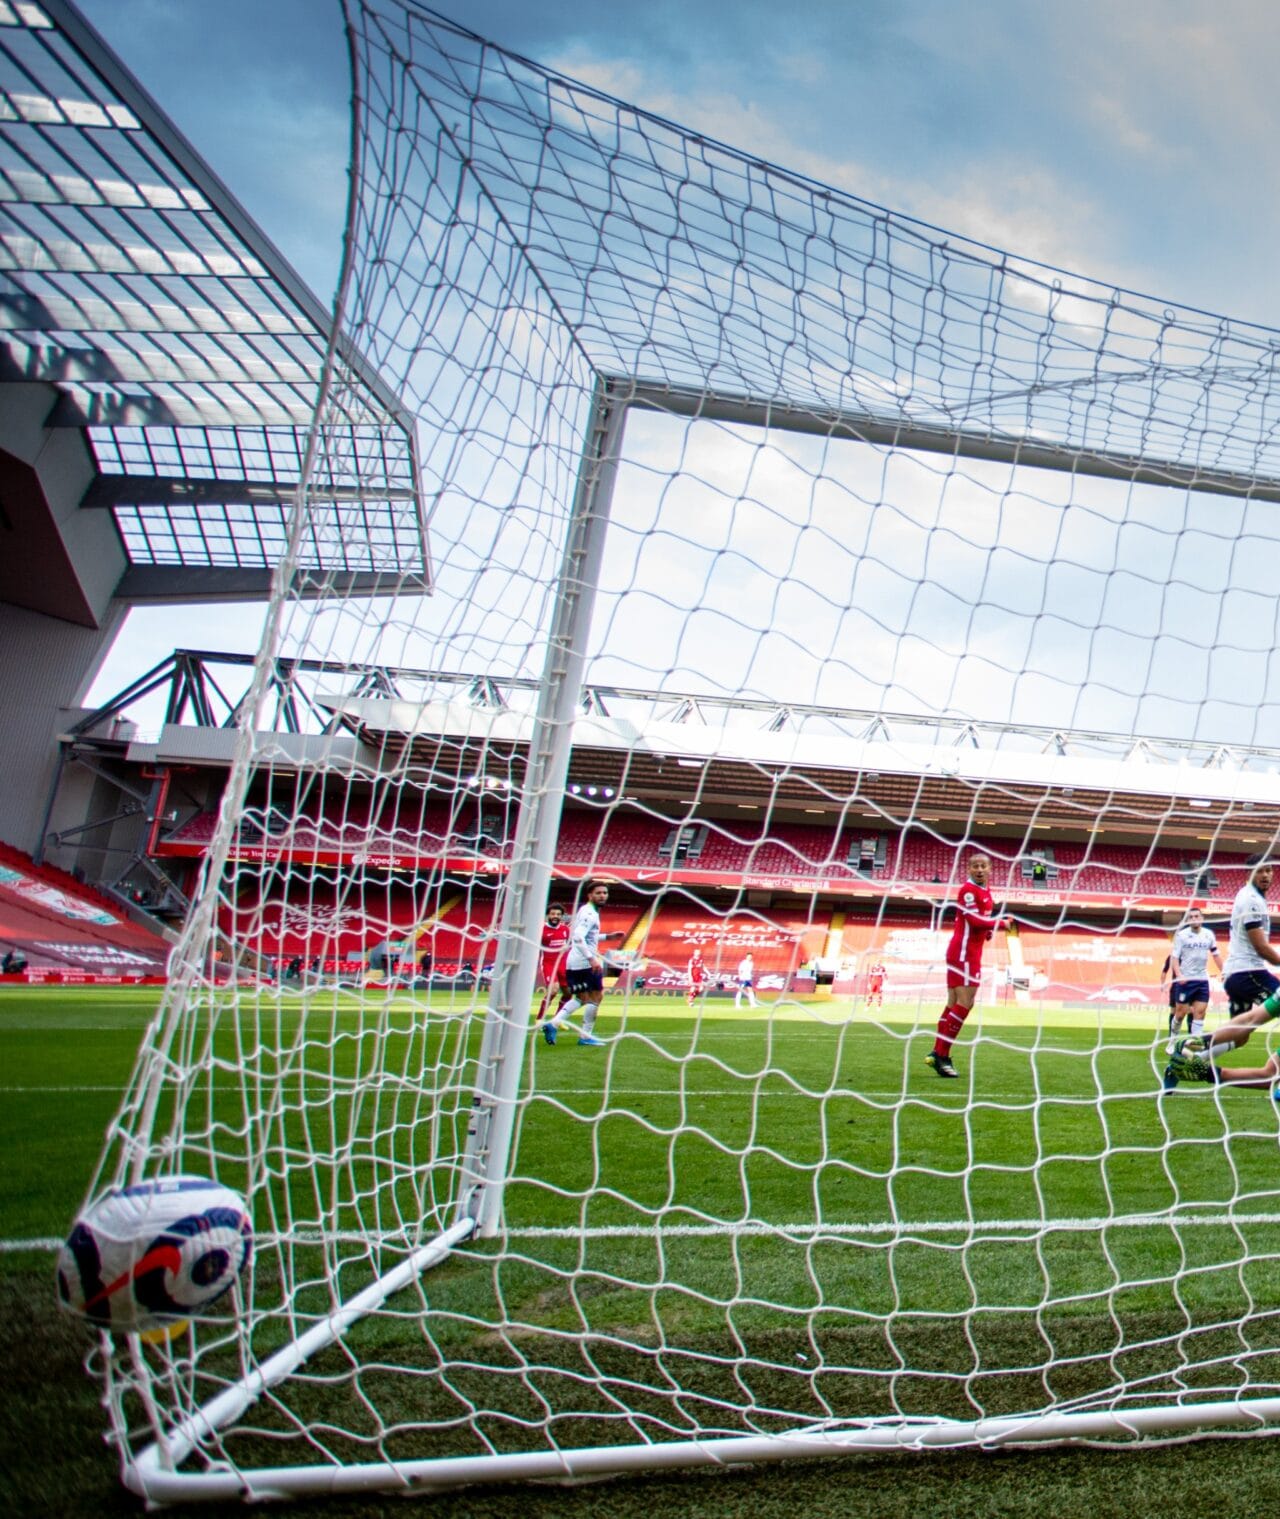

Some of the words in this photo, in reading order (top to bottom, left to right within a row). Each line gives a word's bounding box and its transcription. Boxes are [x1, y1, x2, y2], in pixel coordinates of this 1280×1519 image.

[365, 855, 401, 866] Expedia
[743, 876, 781, 887] Standard
[683, 922, 734, 931] STAY
[671, 930, 770, 940] SUPPORT
[683, 937, 712, 945] AT
